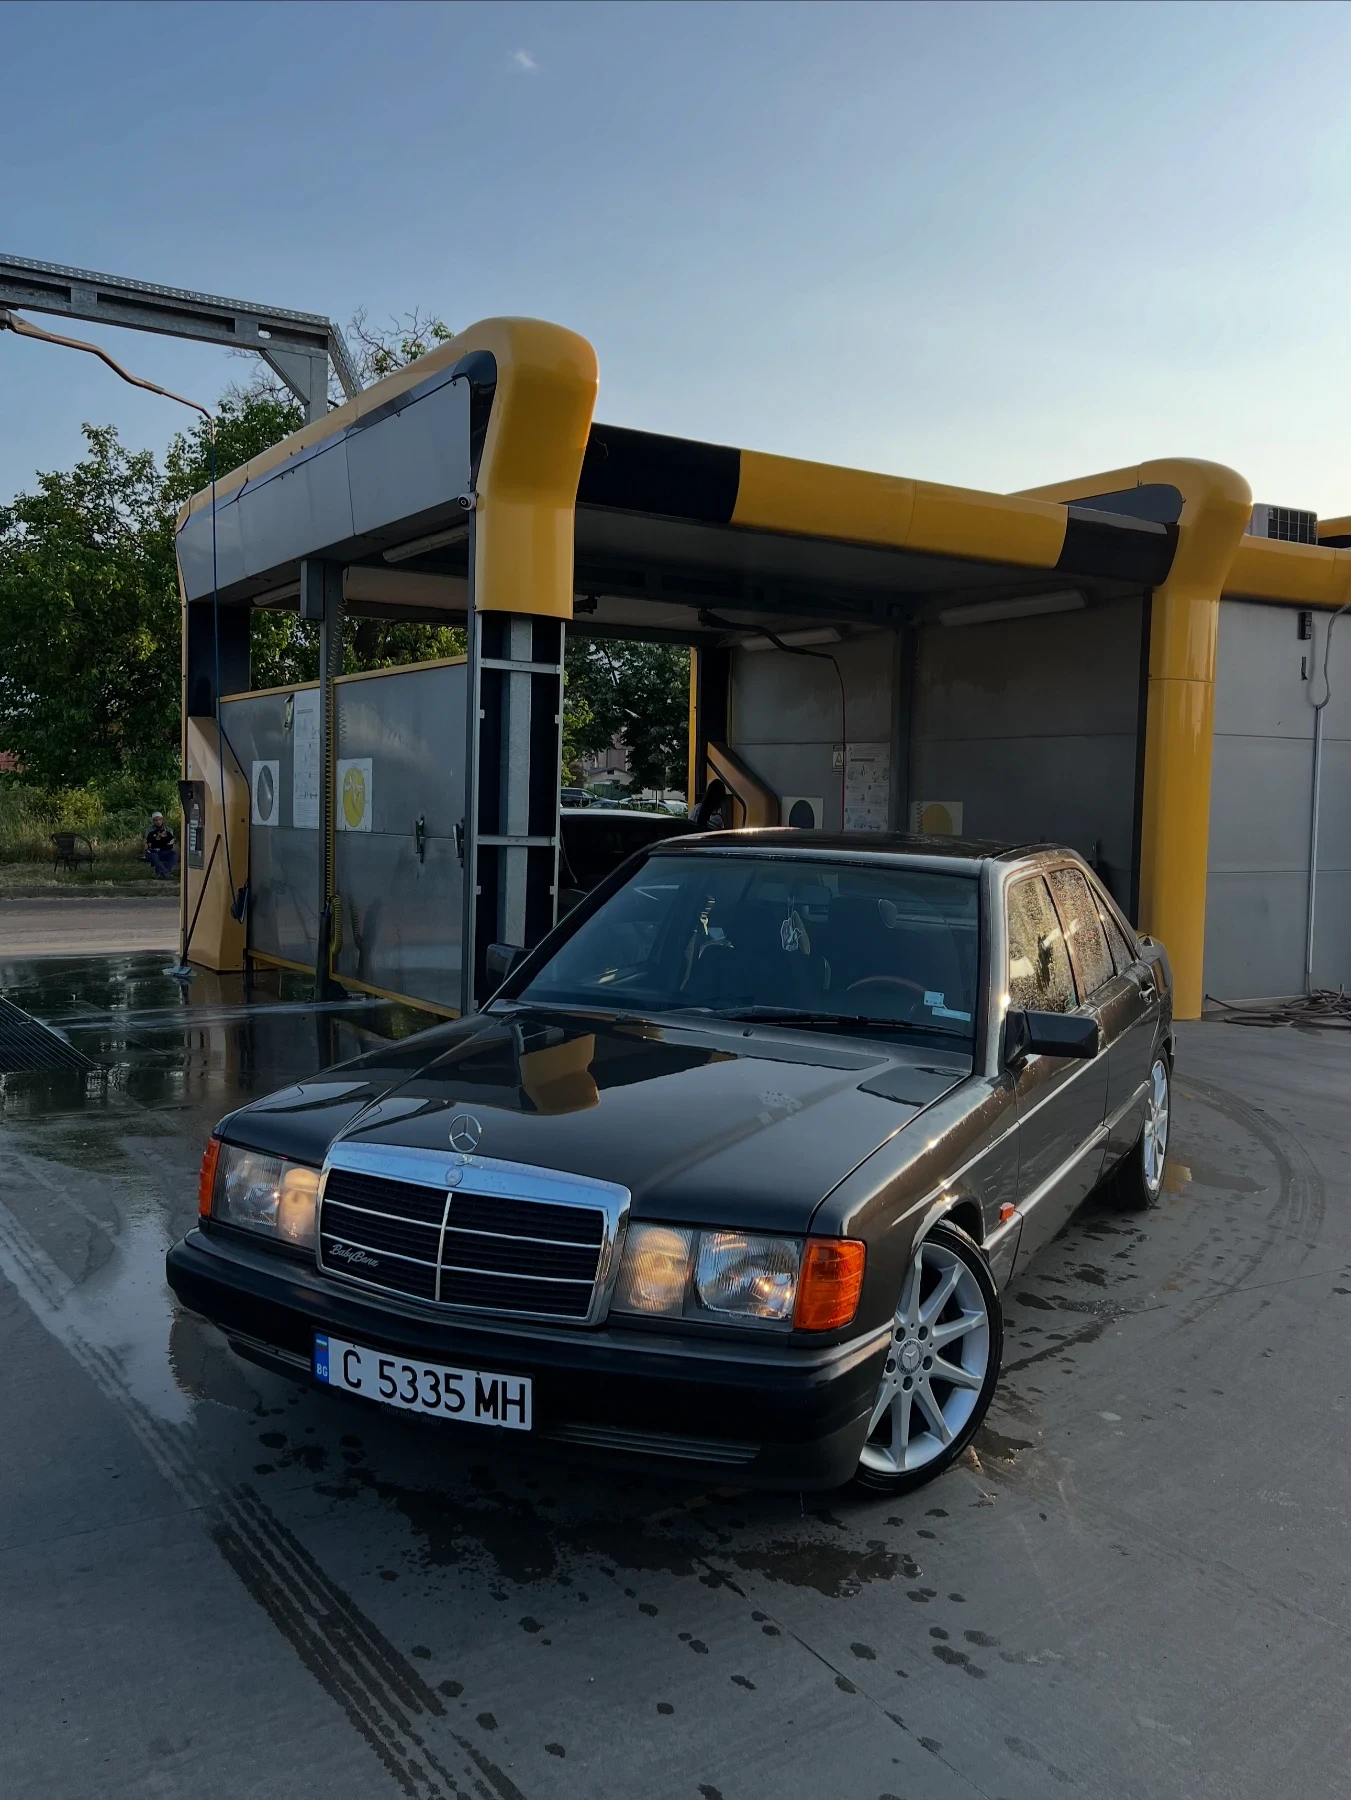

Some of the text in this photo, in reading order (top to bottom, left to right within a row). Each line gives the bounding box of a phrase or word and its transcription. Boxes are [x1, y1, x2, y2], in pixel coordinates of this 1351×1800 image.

[316, 1363, 328, 1377] BG
[343, 1349, 526, 1424] C 5335 MH
